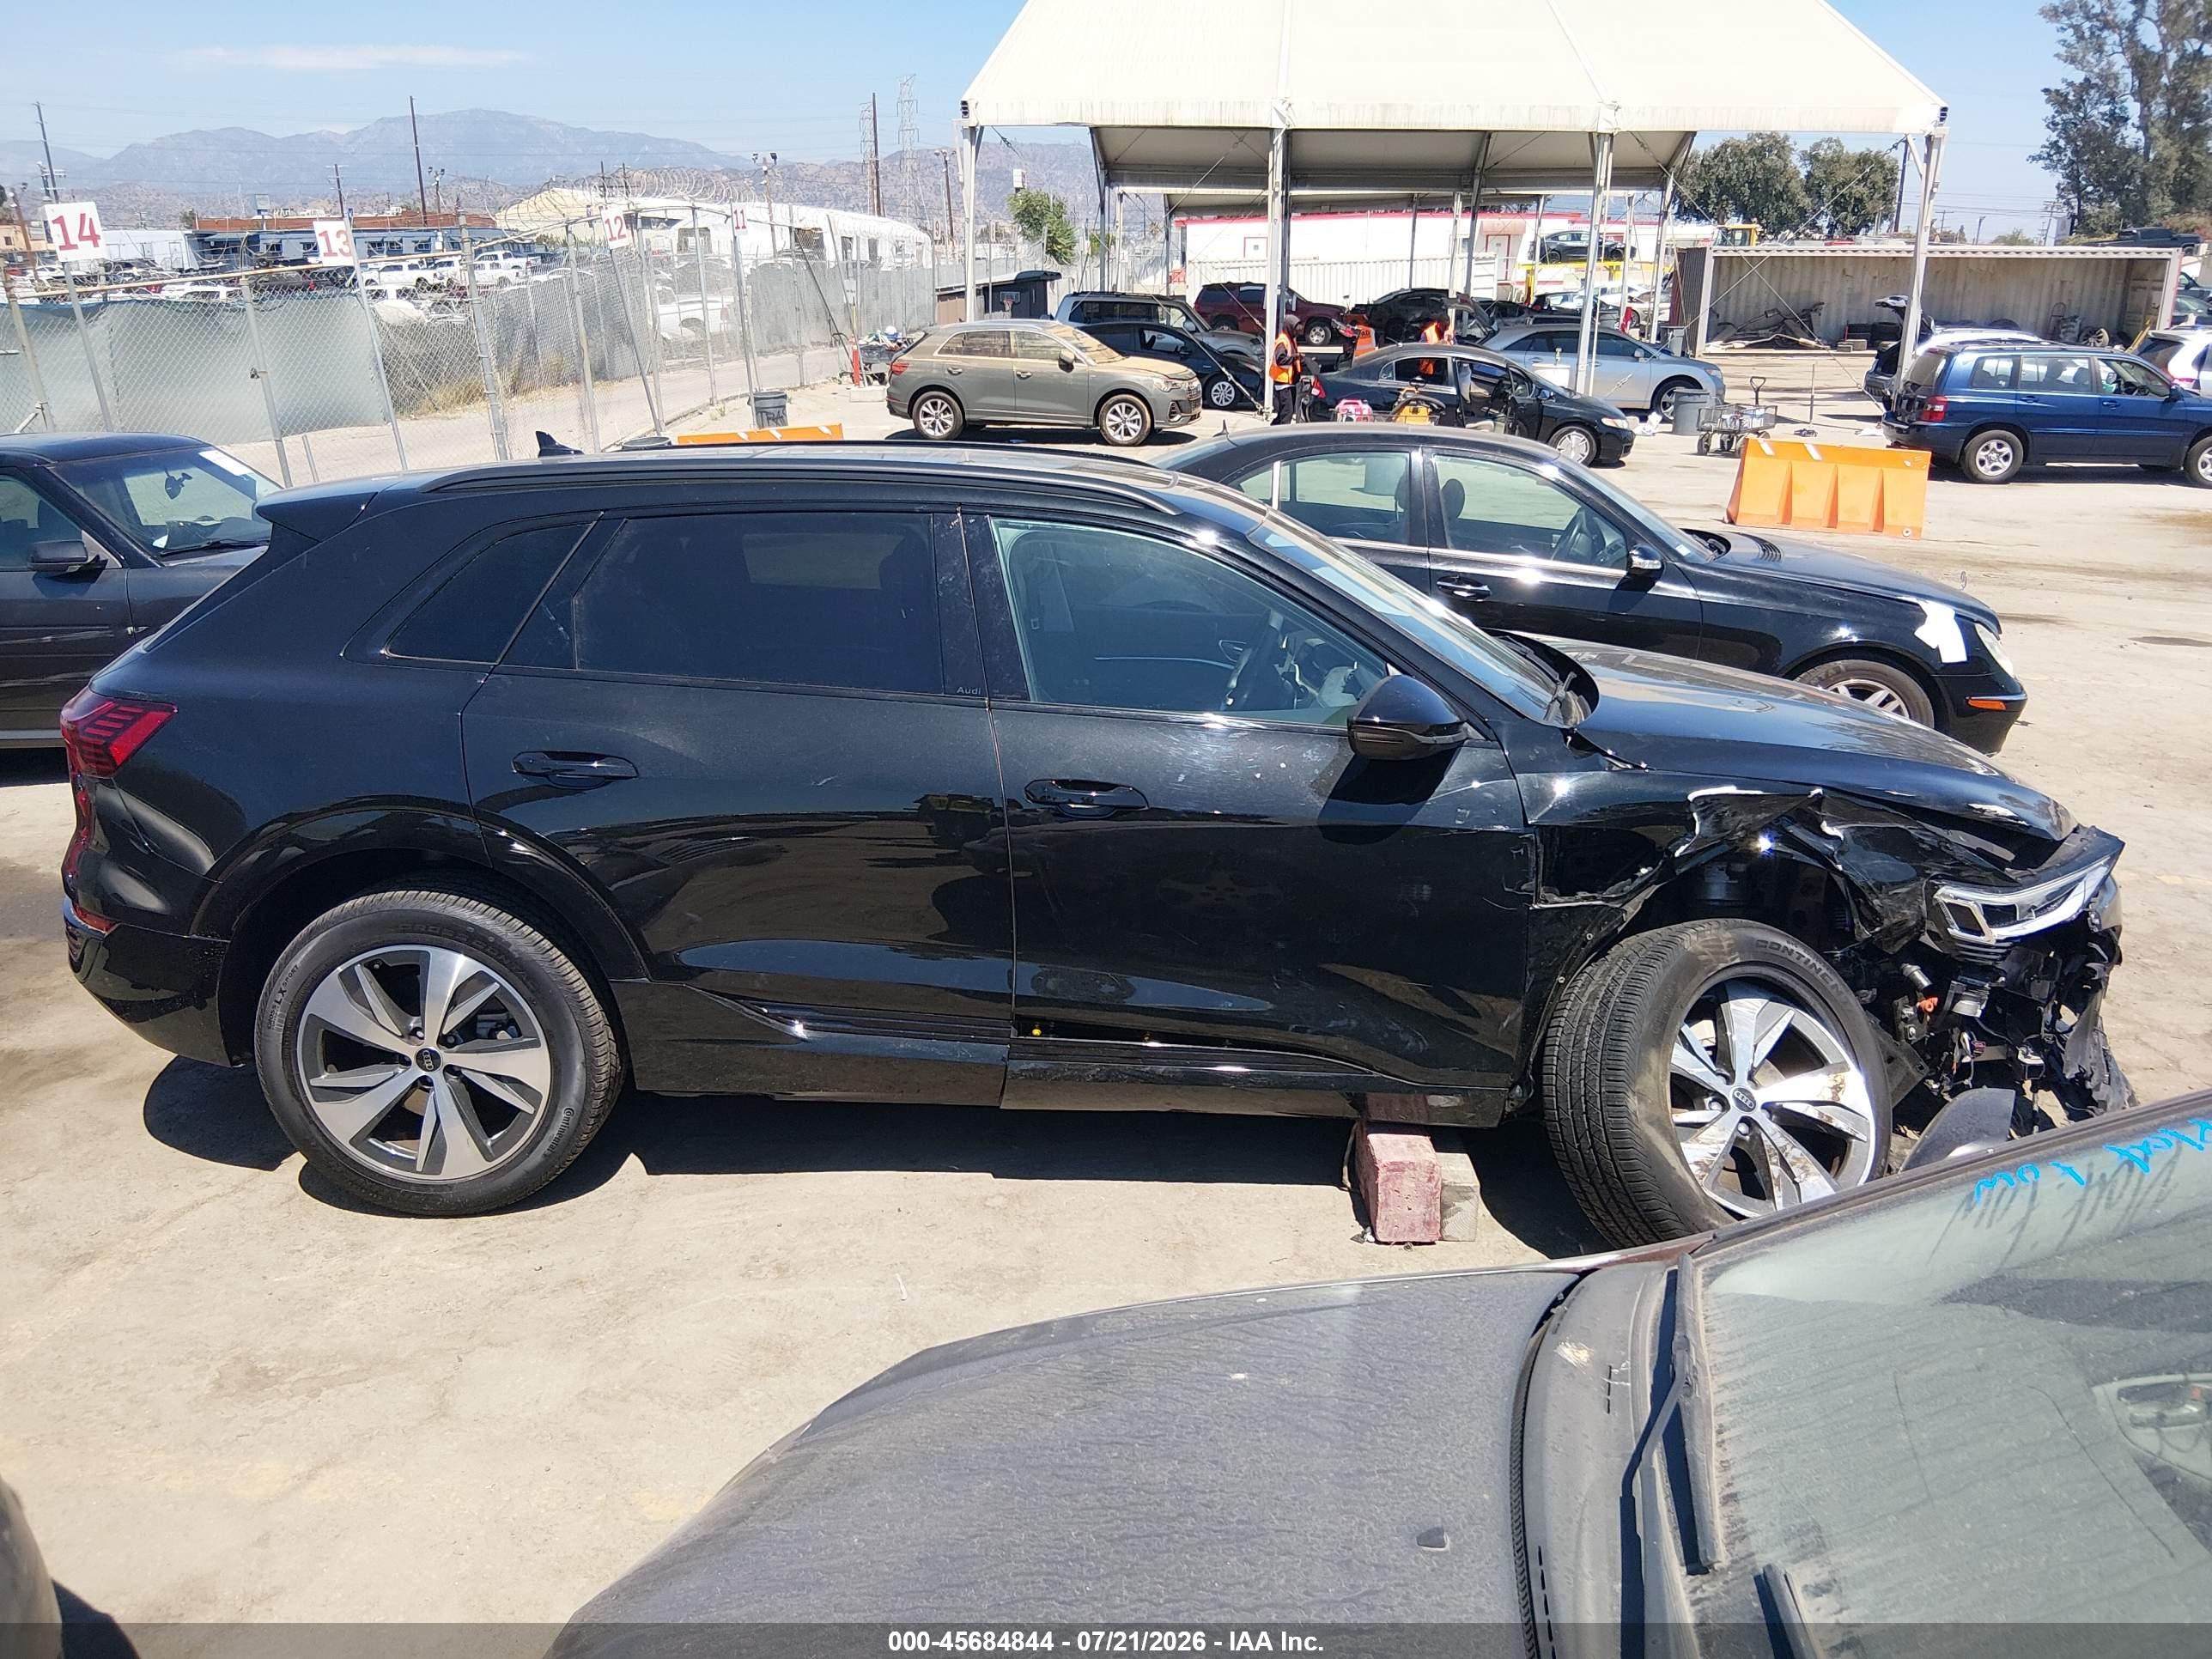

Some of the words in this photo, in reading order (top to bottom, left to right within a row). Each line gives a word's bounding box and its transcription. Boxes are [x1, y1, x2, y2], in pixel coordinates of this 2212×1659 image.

[52, 213, 101, 251] 14
[605, 216, 627, 242] 12
[733, 209, 748, 229] 11
[934, 220, 940, 237] 9
[319, 230, 352, 257] 13
[546, 1107, 574, 1152] Continental
